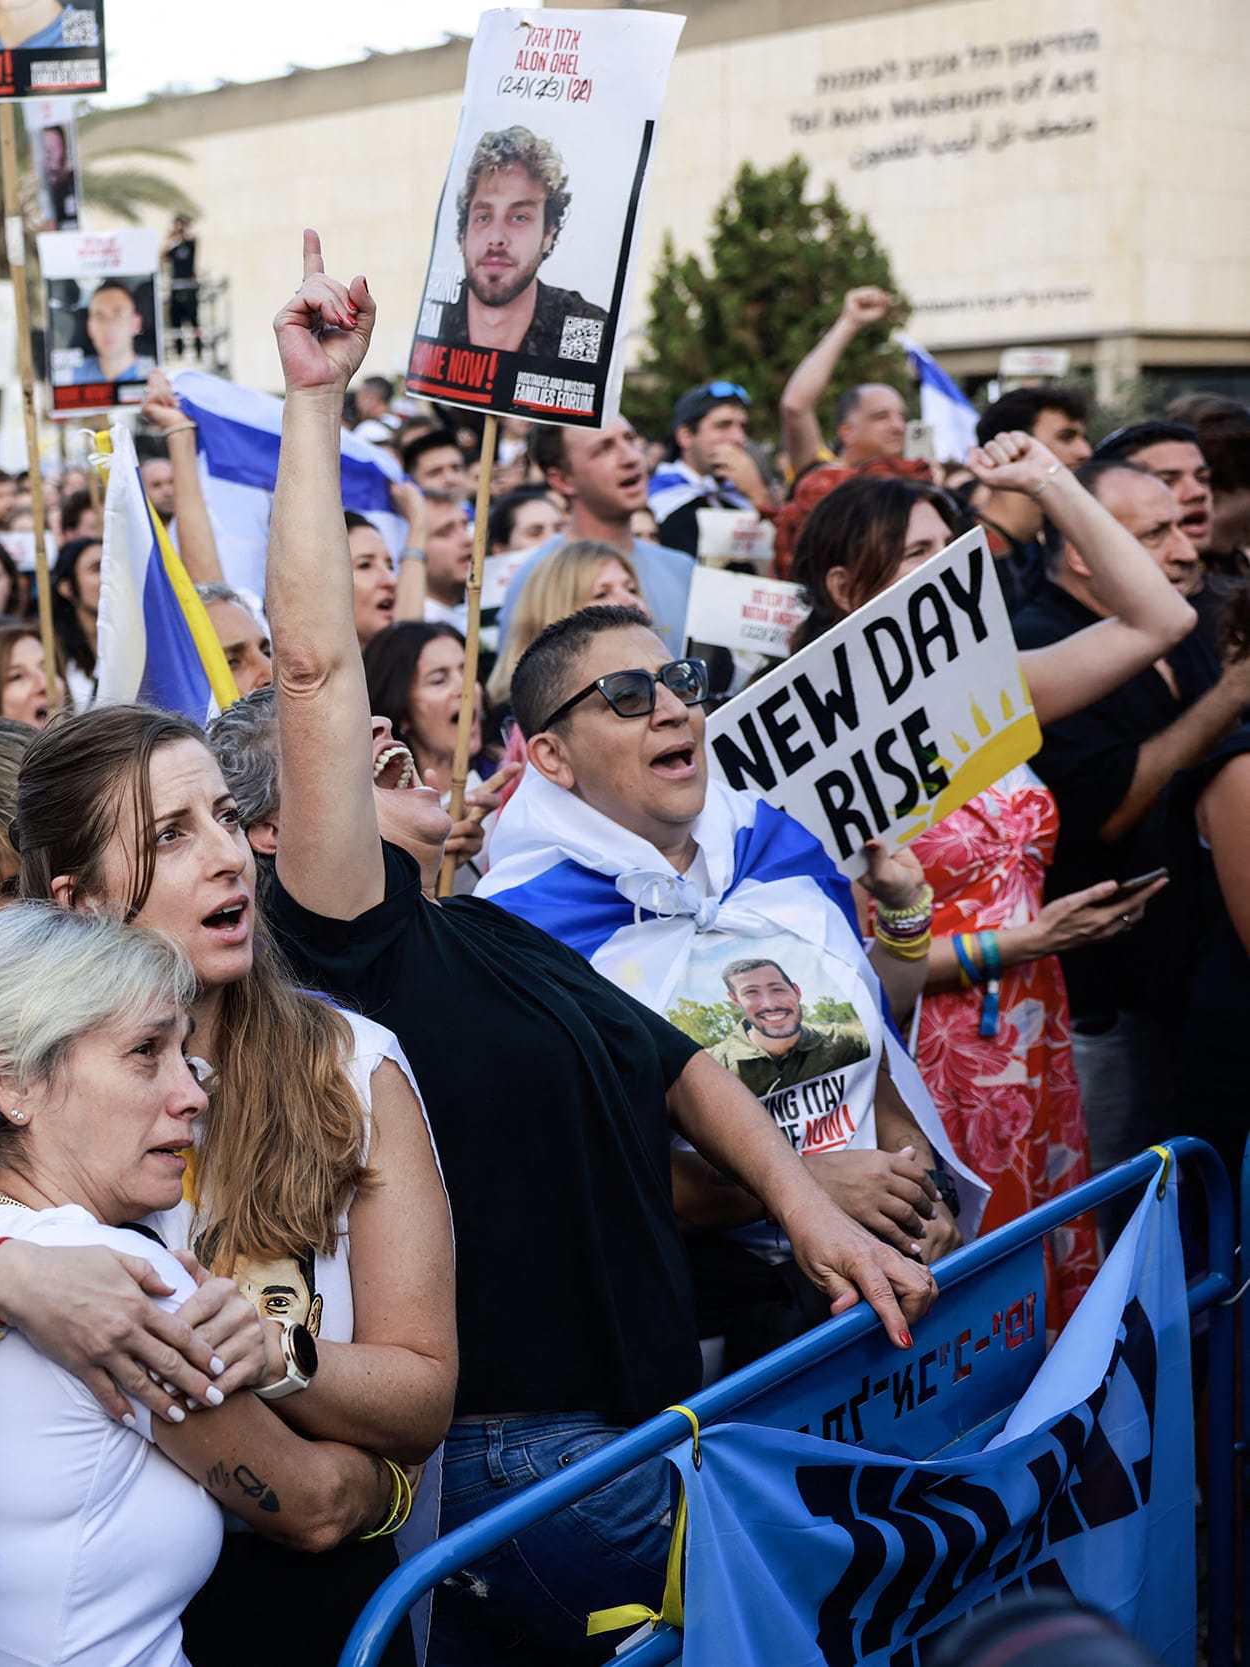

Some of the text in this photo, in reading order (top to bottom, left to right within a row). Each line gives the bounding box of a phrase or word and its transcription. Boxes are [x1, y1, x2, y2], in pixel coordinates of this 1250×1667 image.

[515, 49, 579, 75] ALON OHEL
[525, 27, 581, 51] אלון אהל
[788, 68, 1097, 135] Tel Aviv Museum of Art
[410, 341, 499, 391] HOME NOW!
[514, 384, 595, 413] FAMILIES FORUM
[711, 546, 989, 793] NEW DAY
[814, 706, 951, 862] RISE
[802, 1074, 845, 1116] ITAY
[801, 1103, 856, 1149] NOW!
